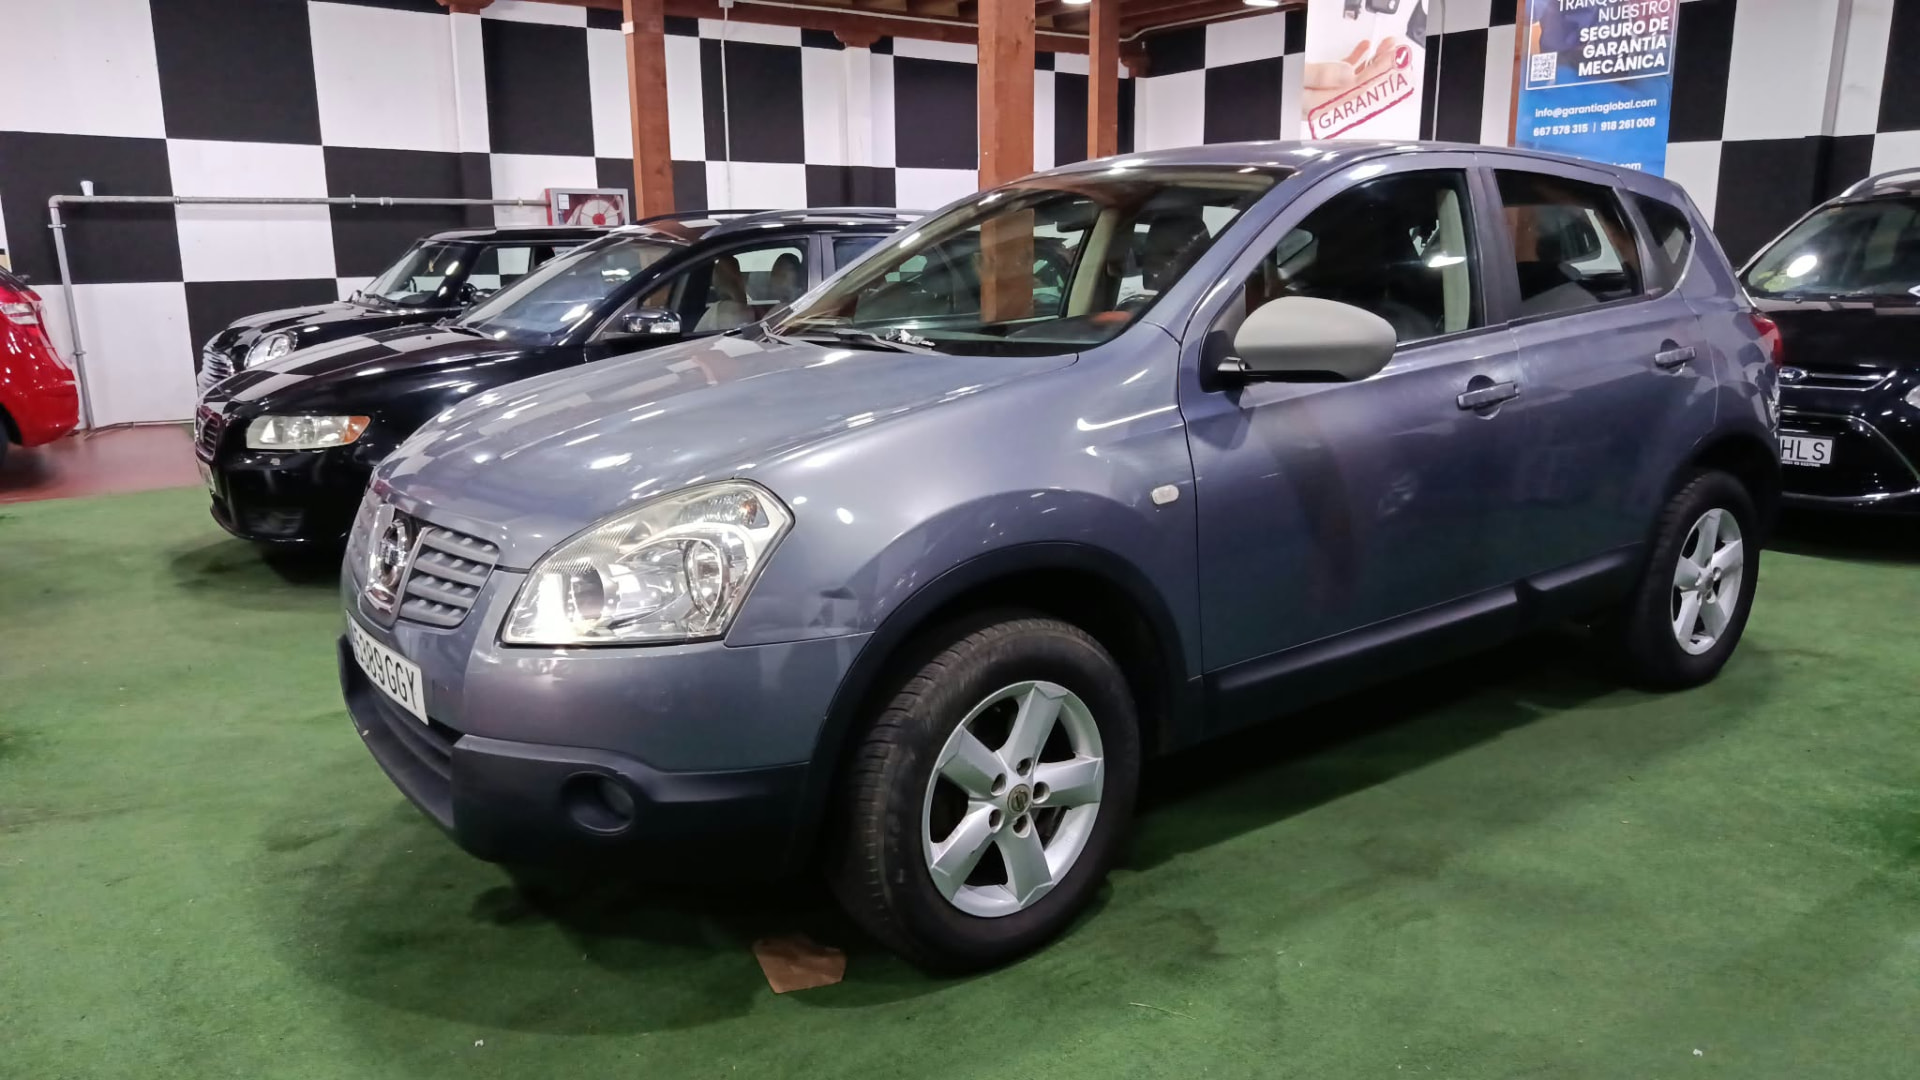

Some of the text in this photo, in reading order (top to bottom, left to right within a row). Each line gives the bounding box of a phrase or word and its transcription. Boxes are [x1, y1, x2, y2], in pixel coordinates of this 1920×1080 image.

[1598, 0, 1670, 22] NUESTRO
[1580, 16, 1670, 42] SEGURO DE
[1582, 32, 1667, 58] GARANTÍA
[1578, 52, 1665, 77] MECÁNICA
[1318, 73, 1408, 129] GARANTÍA
[1534, 98, 1657, 118] info@garantiaglobal.com
[1533, 126, 1551, 137] 667
[1572, 123, 1589, 134] 315
[1600, 120, 1617, 131] 918
[1618, 118, 1636, 130] 261
[1636, 116, 1656, 128] 008
